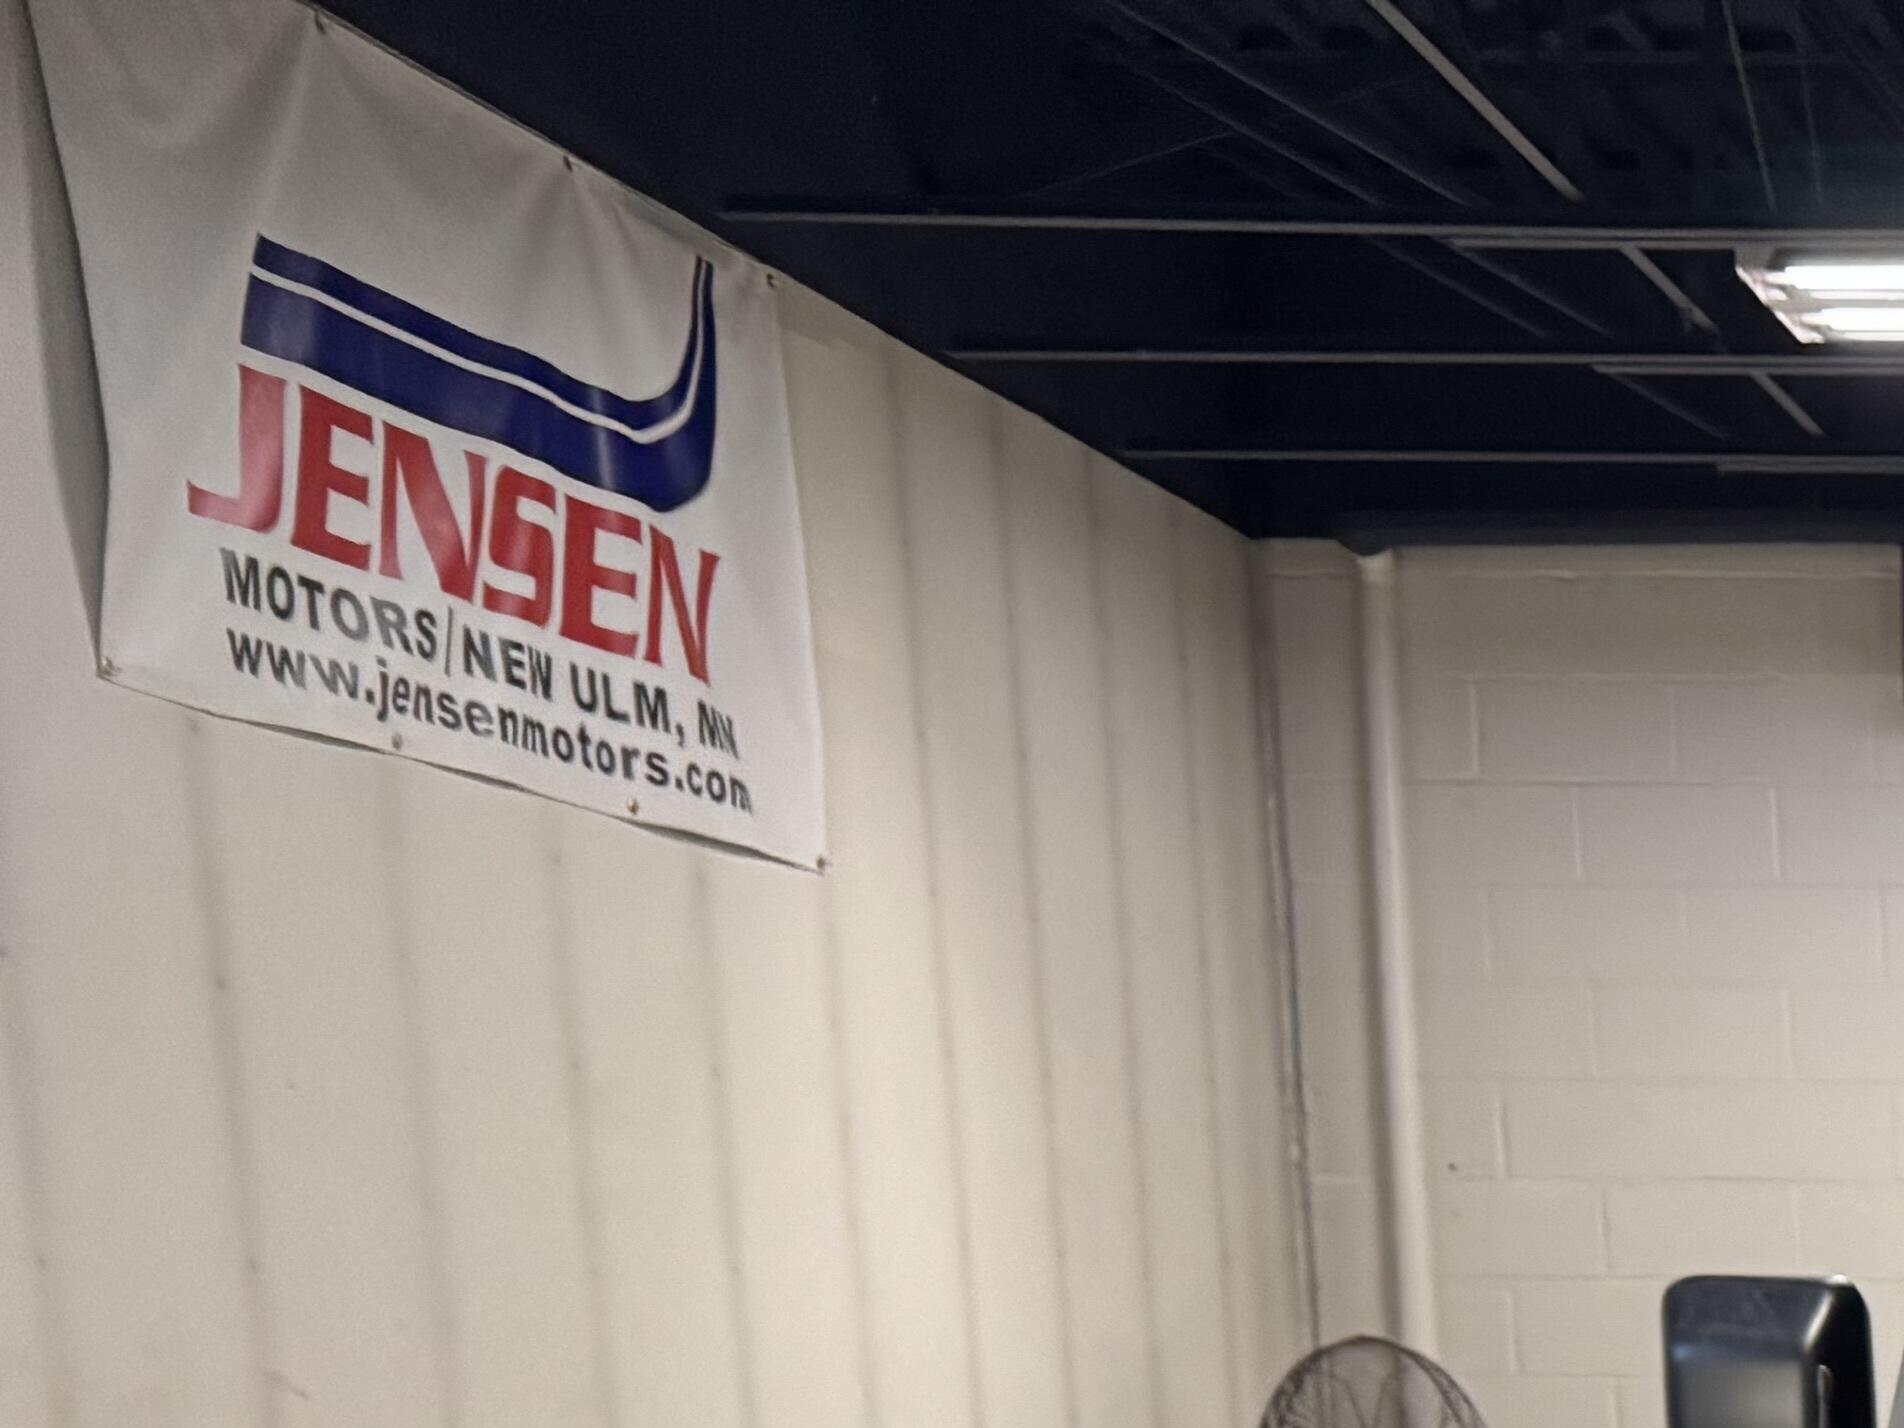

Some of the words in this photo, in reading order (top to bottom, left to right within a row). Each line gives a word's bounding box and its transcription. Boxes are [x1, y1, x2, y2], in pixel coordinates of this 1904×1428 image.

[187, 363, 721, 687] JENSEN
[225, 627, 753, 816] www.jensenmotors.com
[569, 660, 685, 748] ULM,
